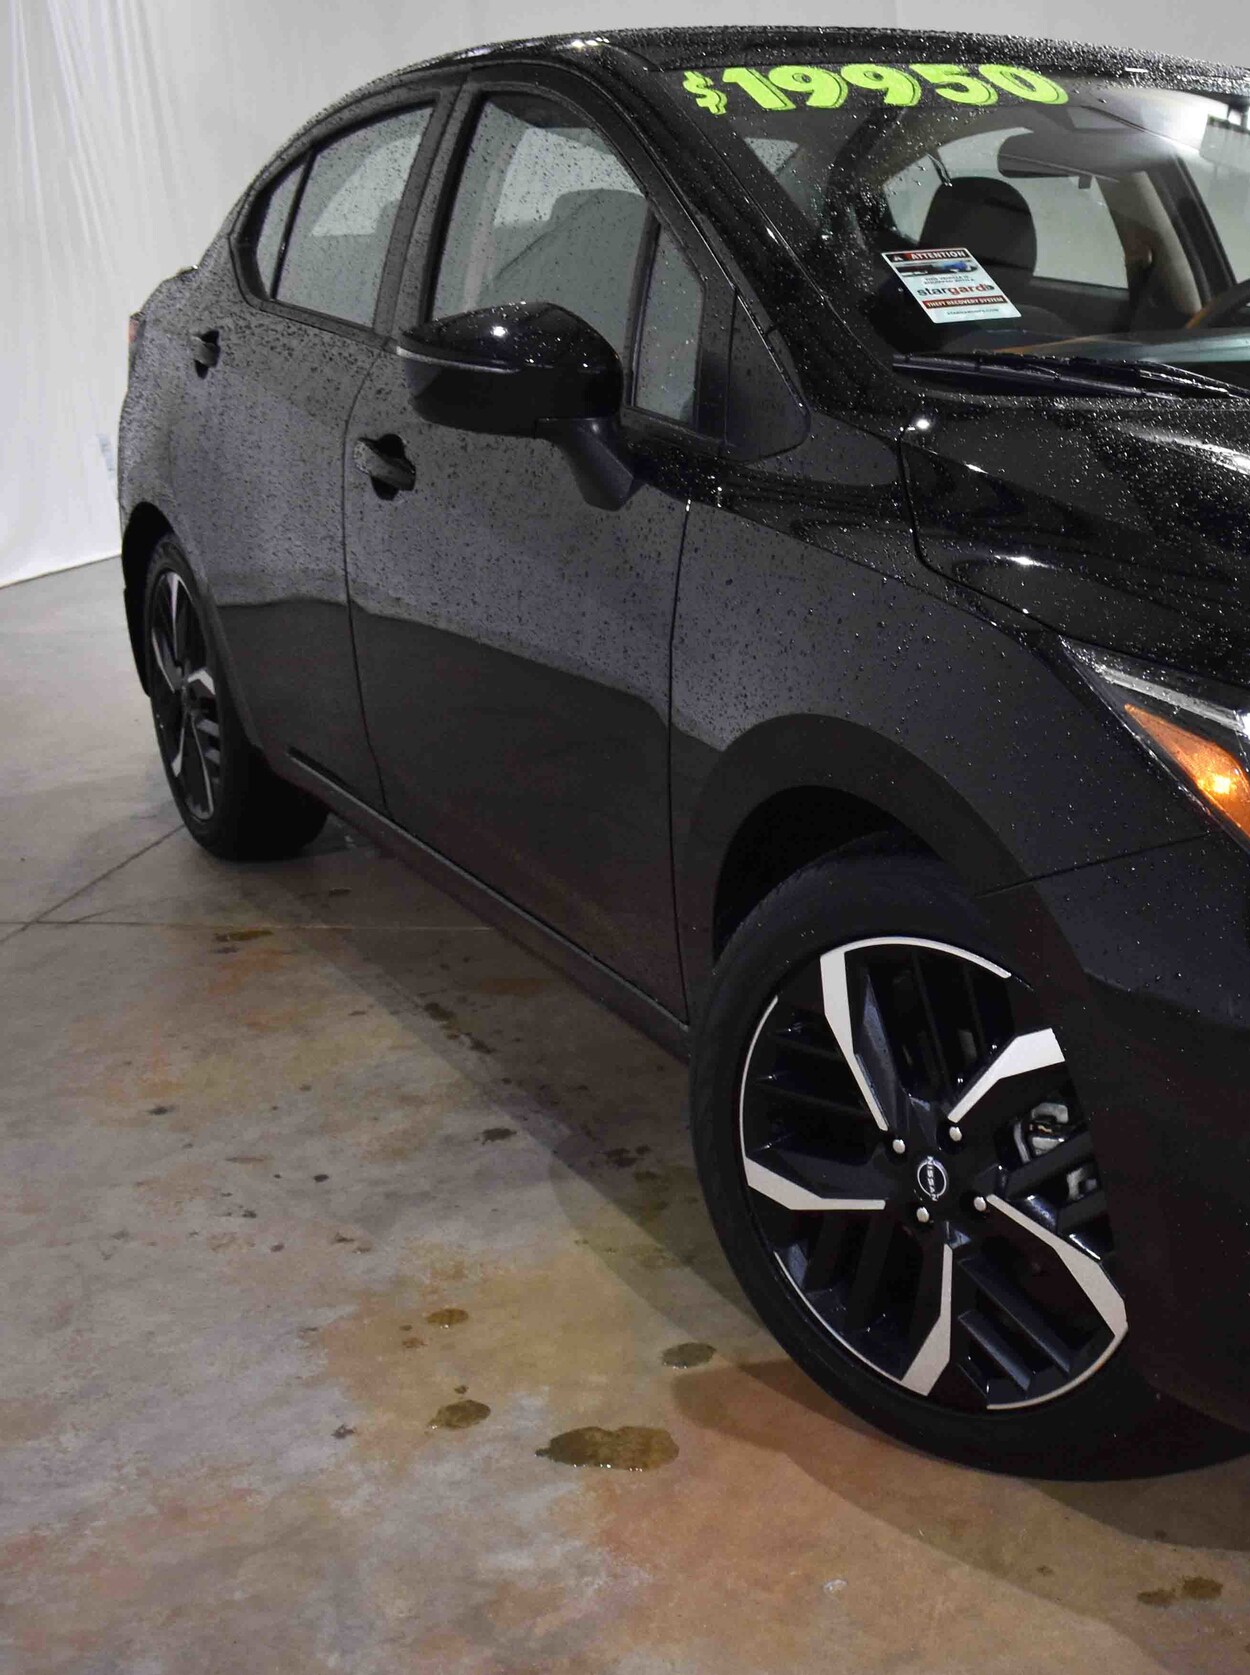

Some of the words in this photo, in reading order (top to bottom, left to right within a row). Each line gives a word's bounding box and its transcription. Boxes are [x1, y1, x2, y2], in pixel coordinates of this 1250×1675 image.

[684, 64, 1068, 115] $19950
[911, 250, 966, 260] ATTENTION
[926, 1155, 938, 1201] NISSAN
